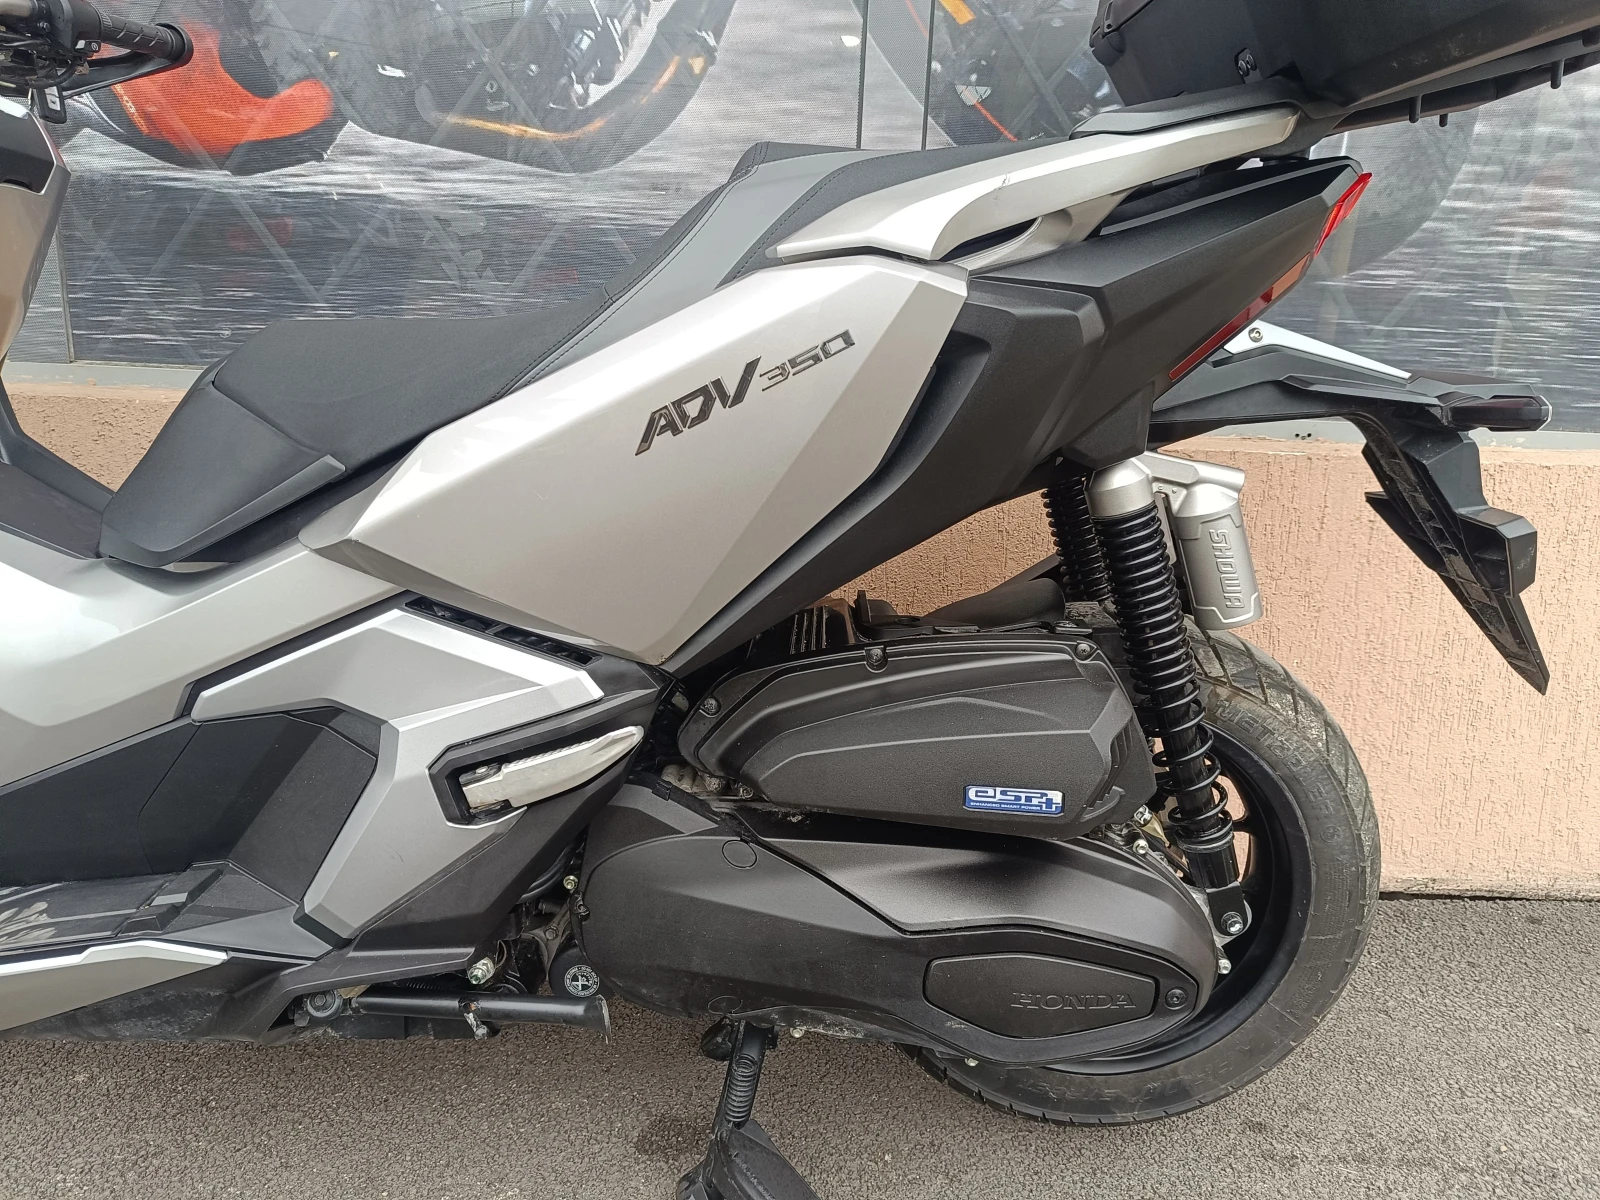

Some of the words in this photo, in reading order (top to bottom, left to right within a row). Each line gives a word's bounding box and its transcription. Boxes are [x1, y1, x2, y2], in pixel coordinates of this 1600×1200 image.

[635, 355, 762, 456] ADV
[759, 329, 855, 392] 350
[1209, 529, 1245, 608] SHOWA
[1010, 992, 1137, 1010] HONDA
